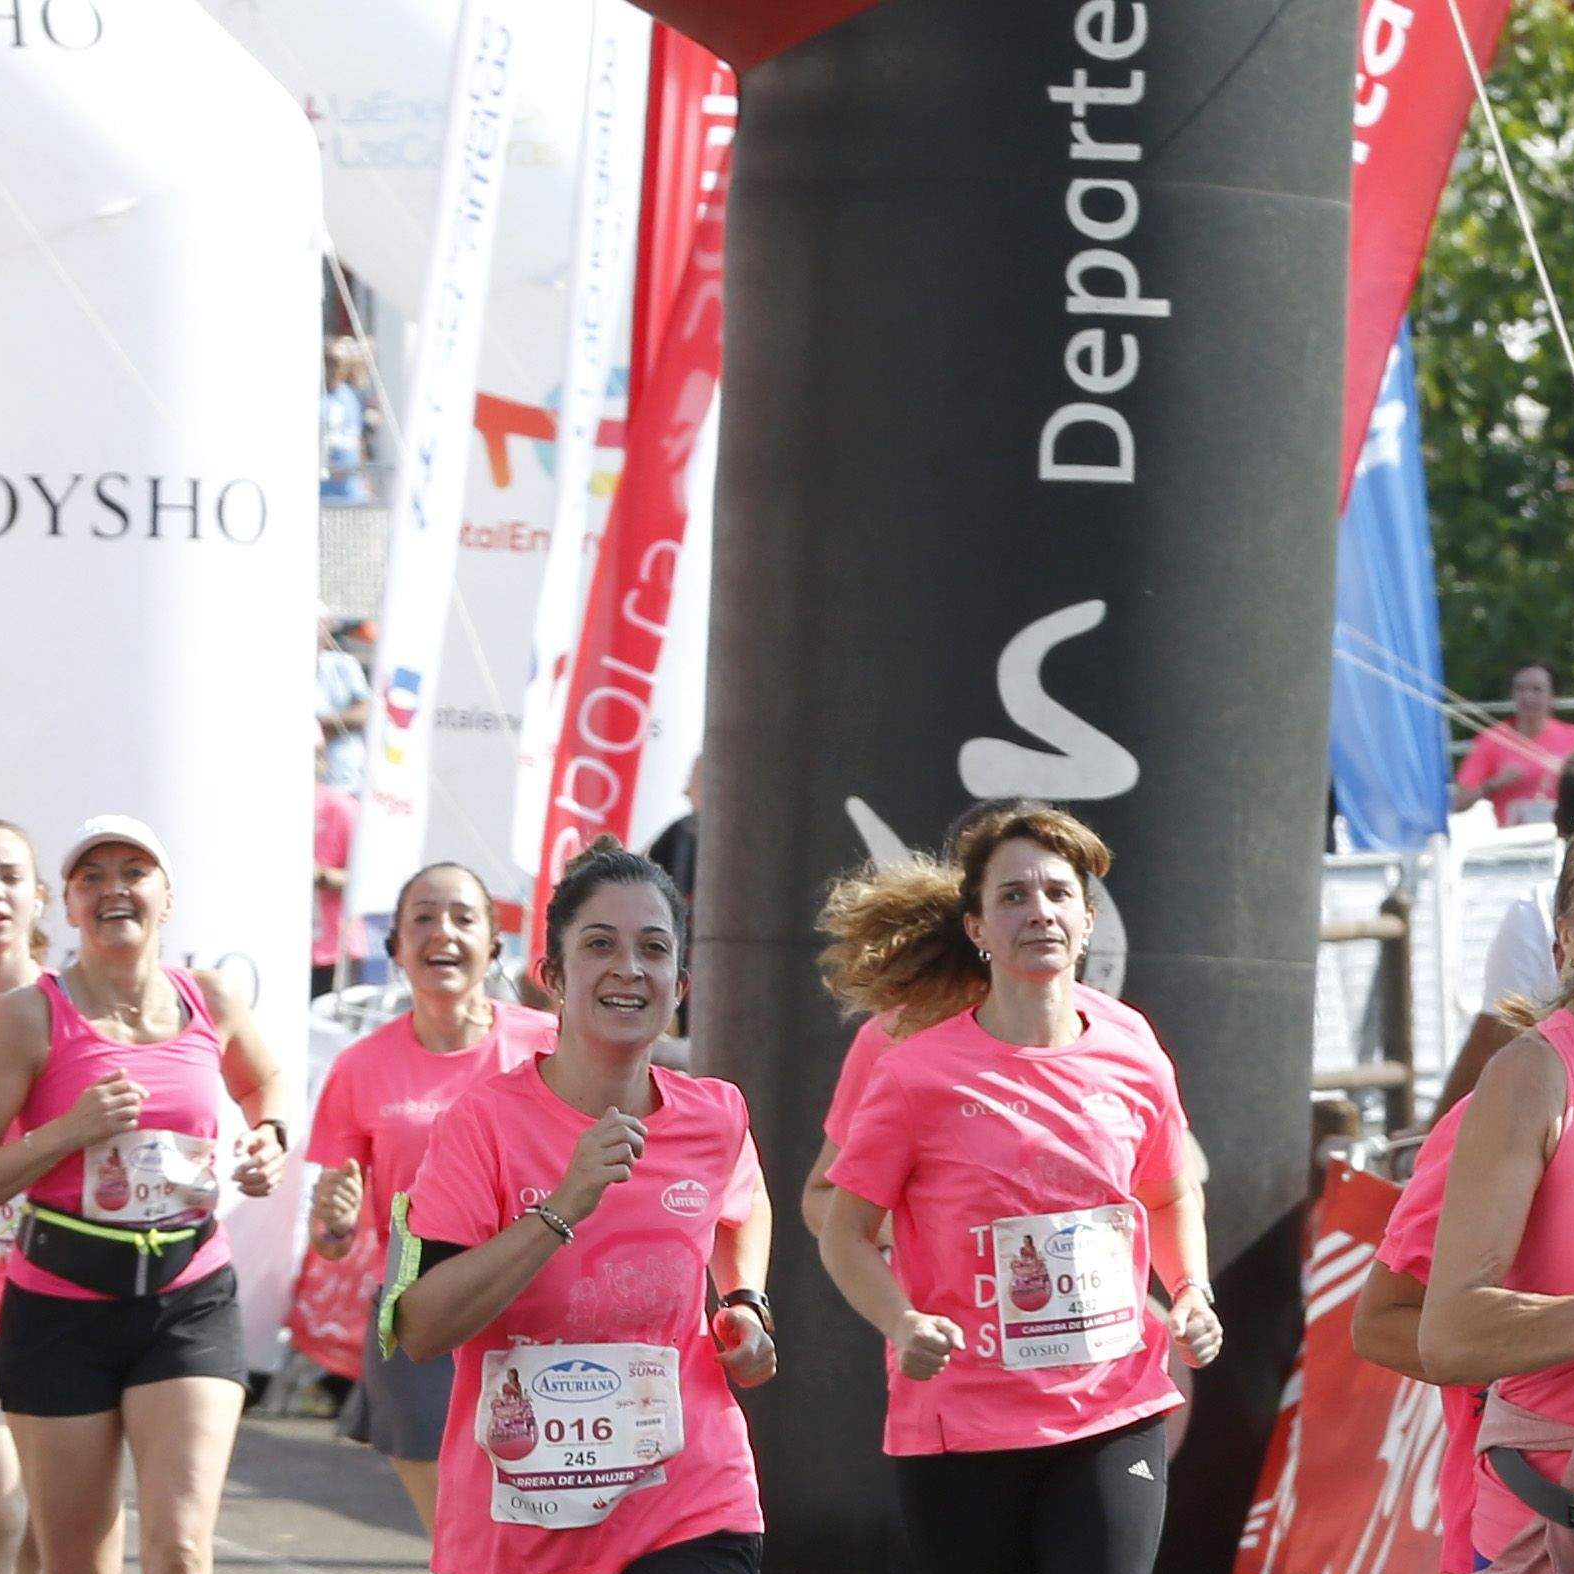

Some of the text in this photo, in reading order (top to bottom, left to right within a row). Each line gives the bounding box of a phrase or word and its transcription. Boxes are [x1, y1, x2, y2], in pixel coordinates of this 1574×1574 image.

[1057, 1270, 1102, 1295] 016
[1019, 1342, 1070, 1359] OYSHO
[629, 1368, 666, 1379] SUMA
[539, 1376, 615, 1393] ASTURIANA
[544, 1416, 613, 1443] 016
[564, 1451, 597, 1467] 245
[512, 1471, 635, 1488] ARRERA DE LA MUJER
